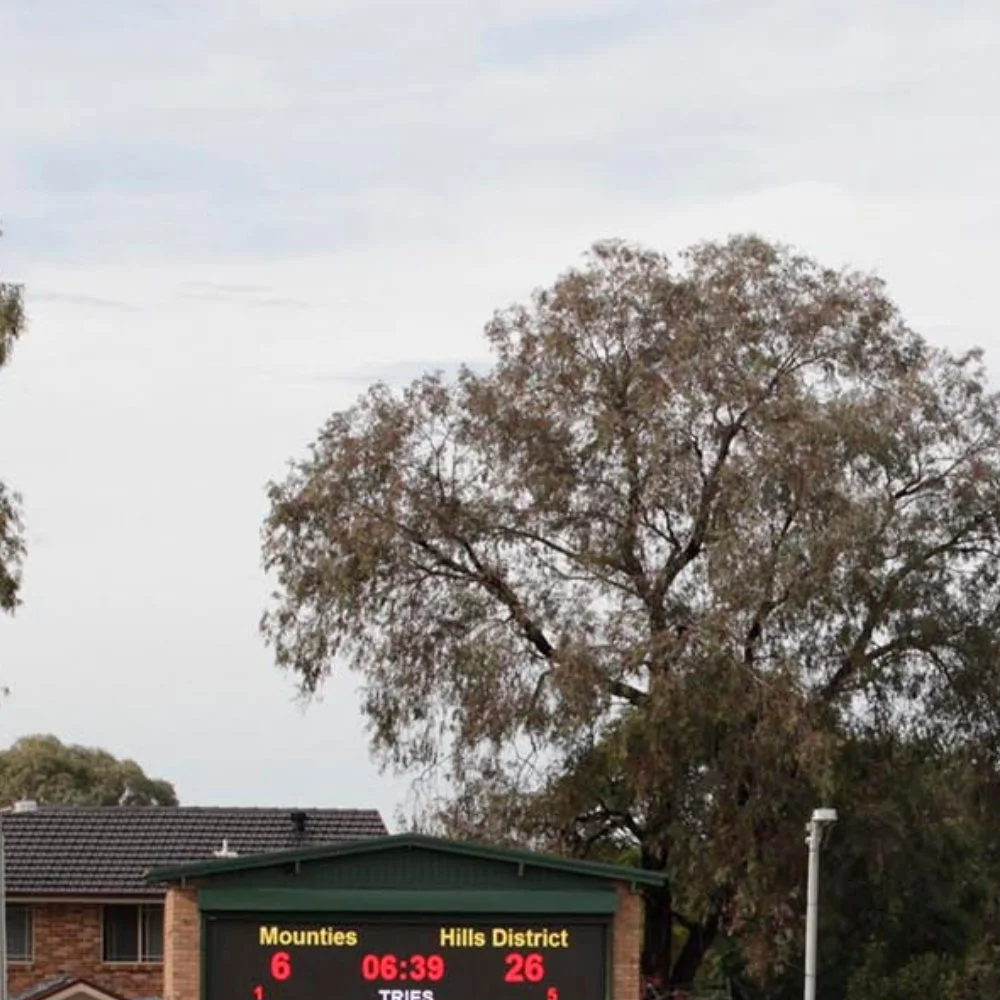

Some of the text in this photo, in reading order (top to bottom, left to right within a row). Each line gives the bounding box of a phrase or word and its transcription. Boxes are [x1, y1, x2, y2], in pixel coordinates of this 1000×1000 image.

[259, 925, 358, 947] Mounties
[439, 927, 569, 948] Hills District
[270, 952, 291, 981] 6
[361, 954, 445, 981] 06:39
[503, 952, 545, 983] 26
